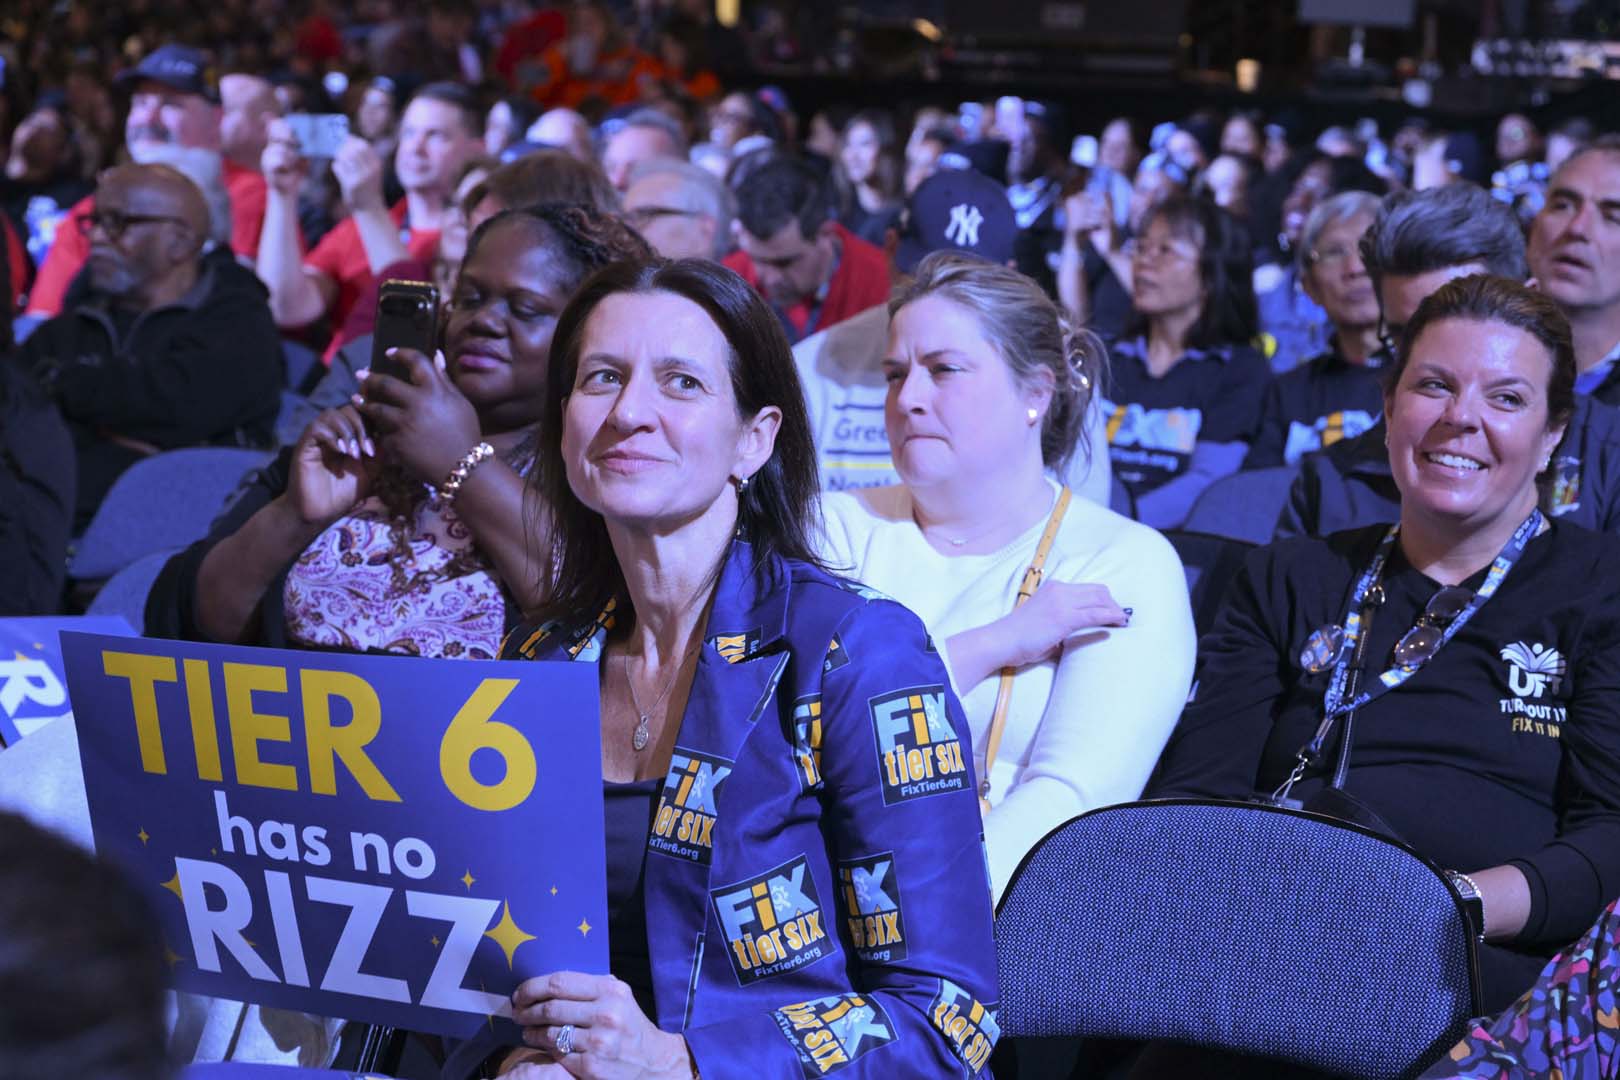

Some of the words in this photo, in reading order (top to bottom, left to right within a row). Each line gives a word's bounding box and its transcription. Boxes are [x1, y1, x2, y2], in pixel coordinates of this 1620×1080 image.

[945, 204, 984, 246] NY
[1508, 665, 1563, 697] UFT
[1500, 698, 1525, 713] TUR
[1525, 704, 1551, 719] OUT
[1512, 717, 1533, 732] FIX
[1535, 721, 1545, 735] IT
[102, 650, 402, 802] TIER
[439, 677, 537, 811] 6
[884, 743, 934, 787] tier
[900, 777, 963, 797] FixTier6.org
[213, 790, 331, 867] has
[350, 831, 436, 880] no
[651, 796, 683, 838] ier
[648, 836, 699, 861] ixTier6.org
[174, 856, 514, 1019] RIZZ
[732, 927, 788, 970] tier
[753, 946, 822, 977] FixTier6.org
